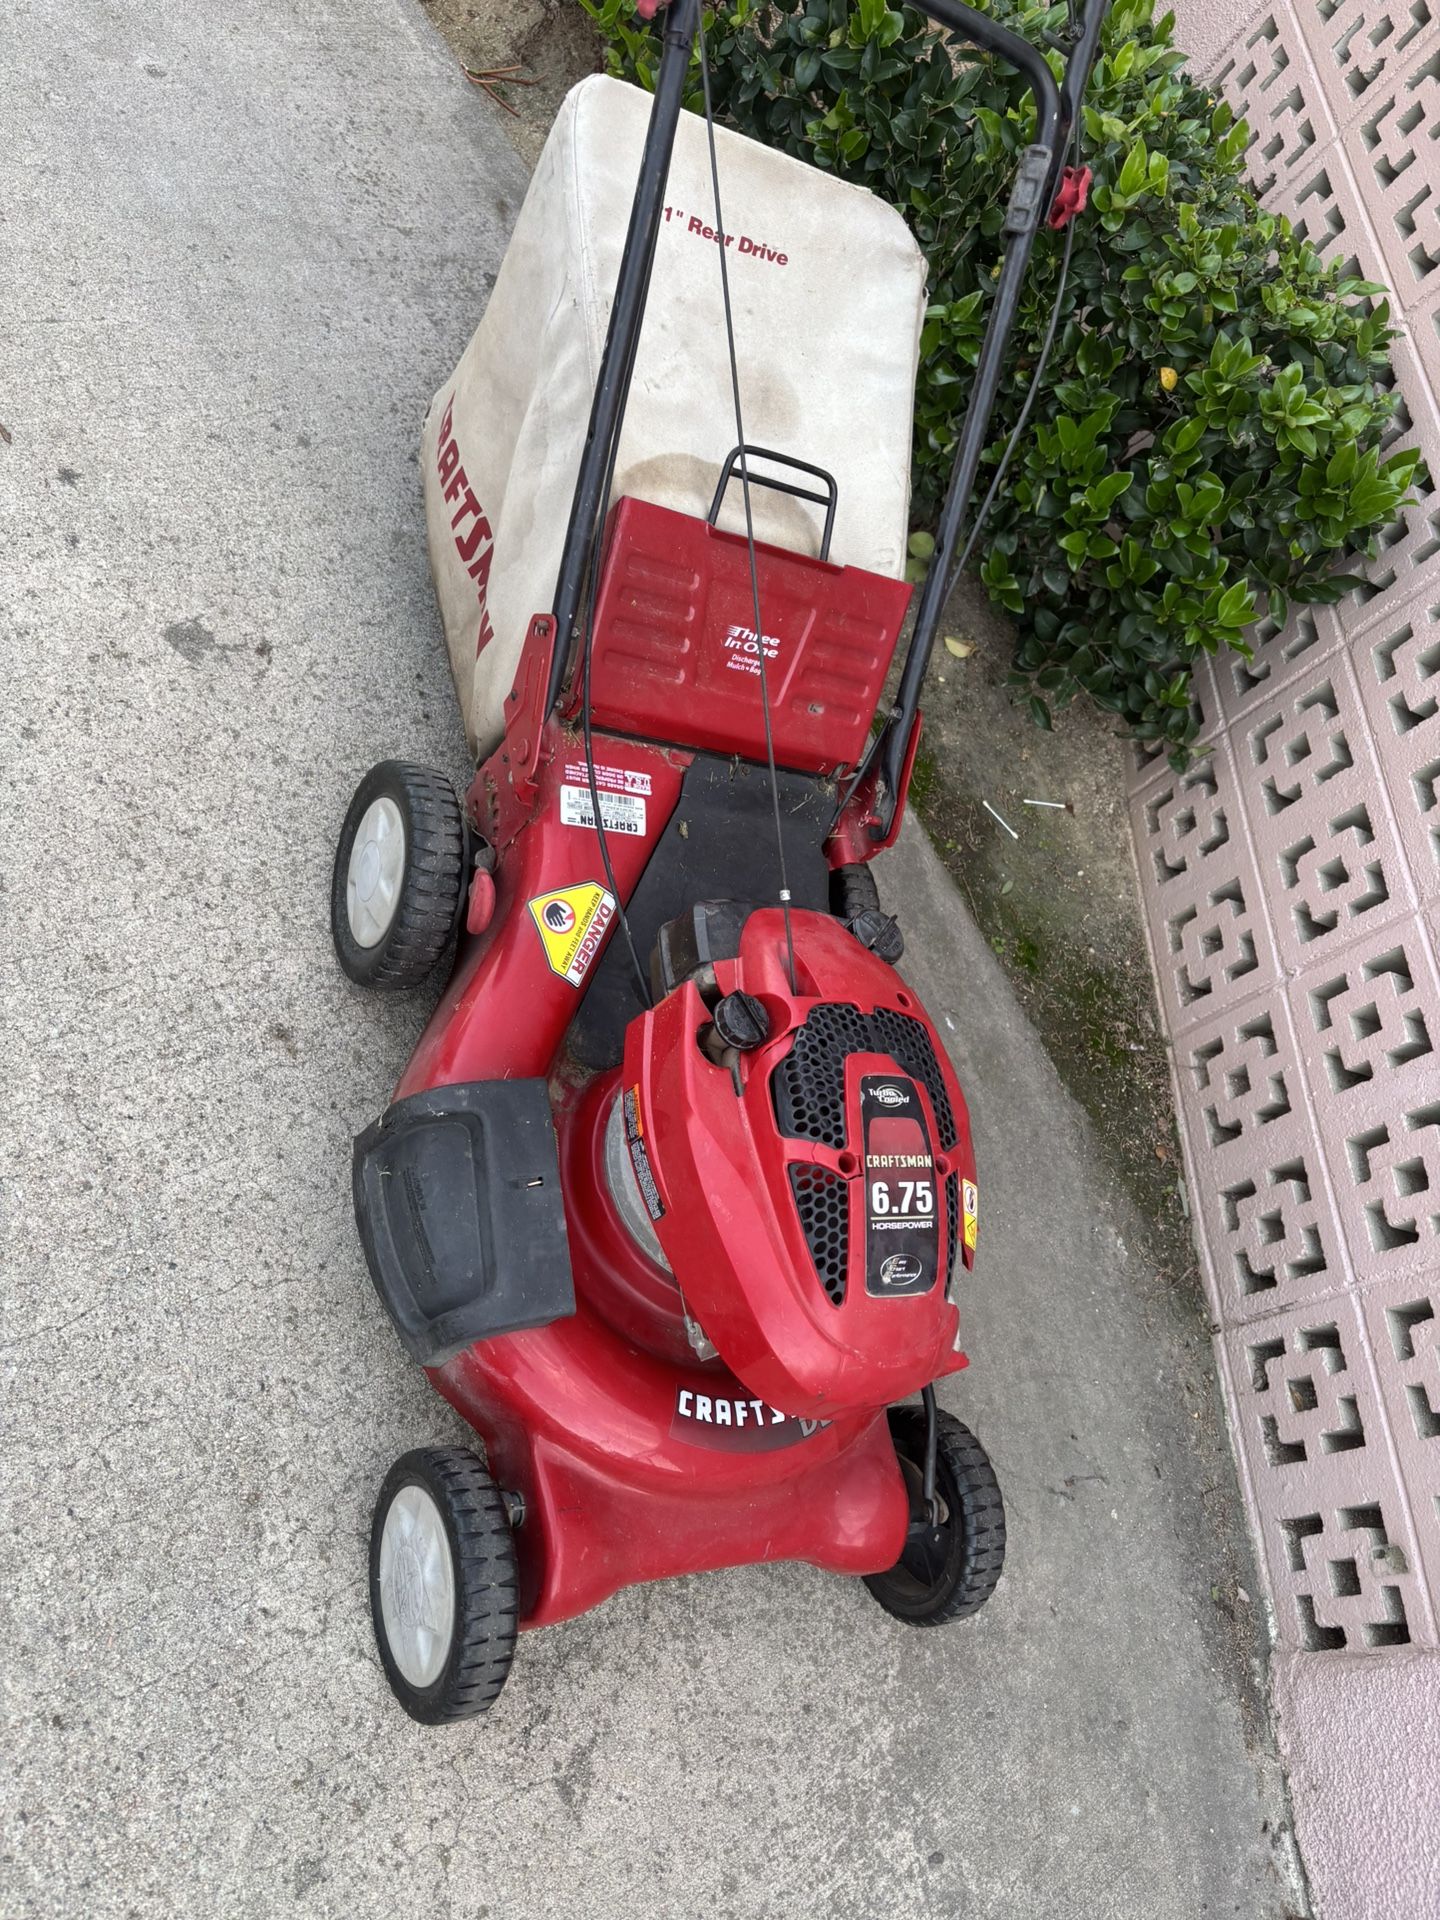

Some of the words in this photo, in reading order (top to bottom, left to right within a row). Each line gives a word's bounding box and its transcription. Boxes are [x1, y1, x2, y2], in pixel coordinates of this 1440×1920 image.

[664, 206, 684, 222] 1"
[687, 215, 735, 247] Rear
[738, 236, 789, 266] Drive
[437, 389, 495, 662] RAFTSMN
[727, 624, 780, 647] Three
[724, 636, 742, 649] In
[743, 642, 779, 658] One
[726, 661, 745, 671] Mulch
[749, 666, 762, 676] Bag
[731, 653, 760, 666] Discharge
[580, 815, 638, 833] CRAFTSAN
[592, 892, 601, 907] KEEP
[581, 906, 593, 928] HANDS
[571, 902, 612, 975] DANGER
[575, 926, 583, 938] and
[569, 937, 579, 952] FEET
[561, 951, 573, 970] AWAY
[868, 1087, 898, 1098] Turbo
[878, 1095, 911, 1104] Cooled
[866, 1154, 933, 1168] CRAFTSMAN
[871, 1181, 933, 1214] 6.75
[871, 1221, 933, 1230] HORSEPOWER
[678, 1389, 798, 1427] CRAFTS
